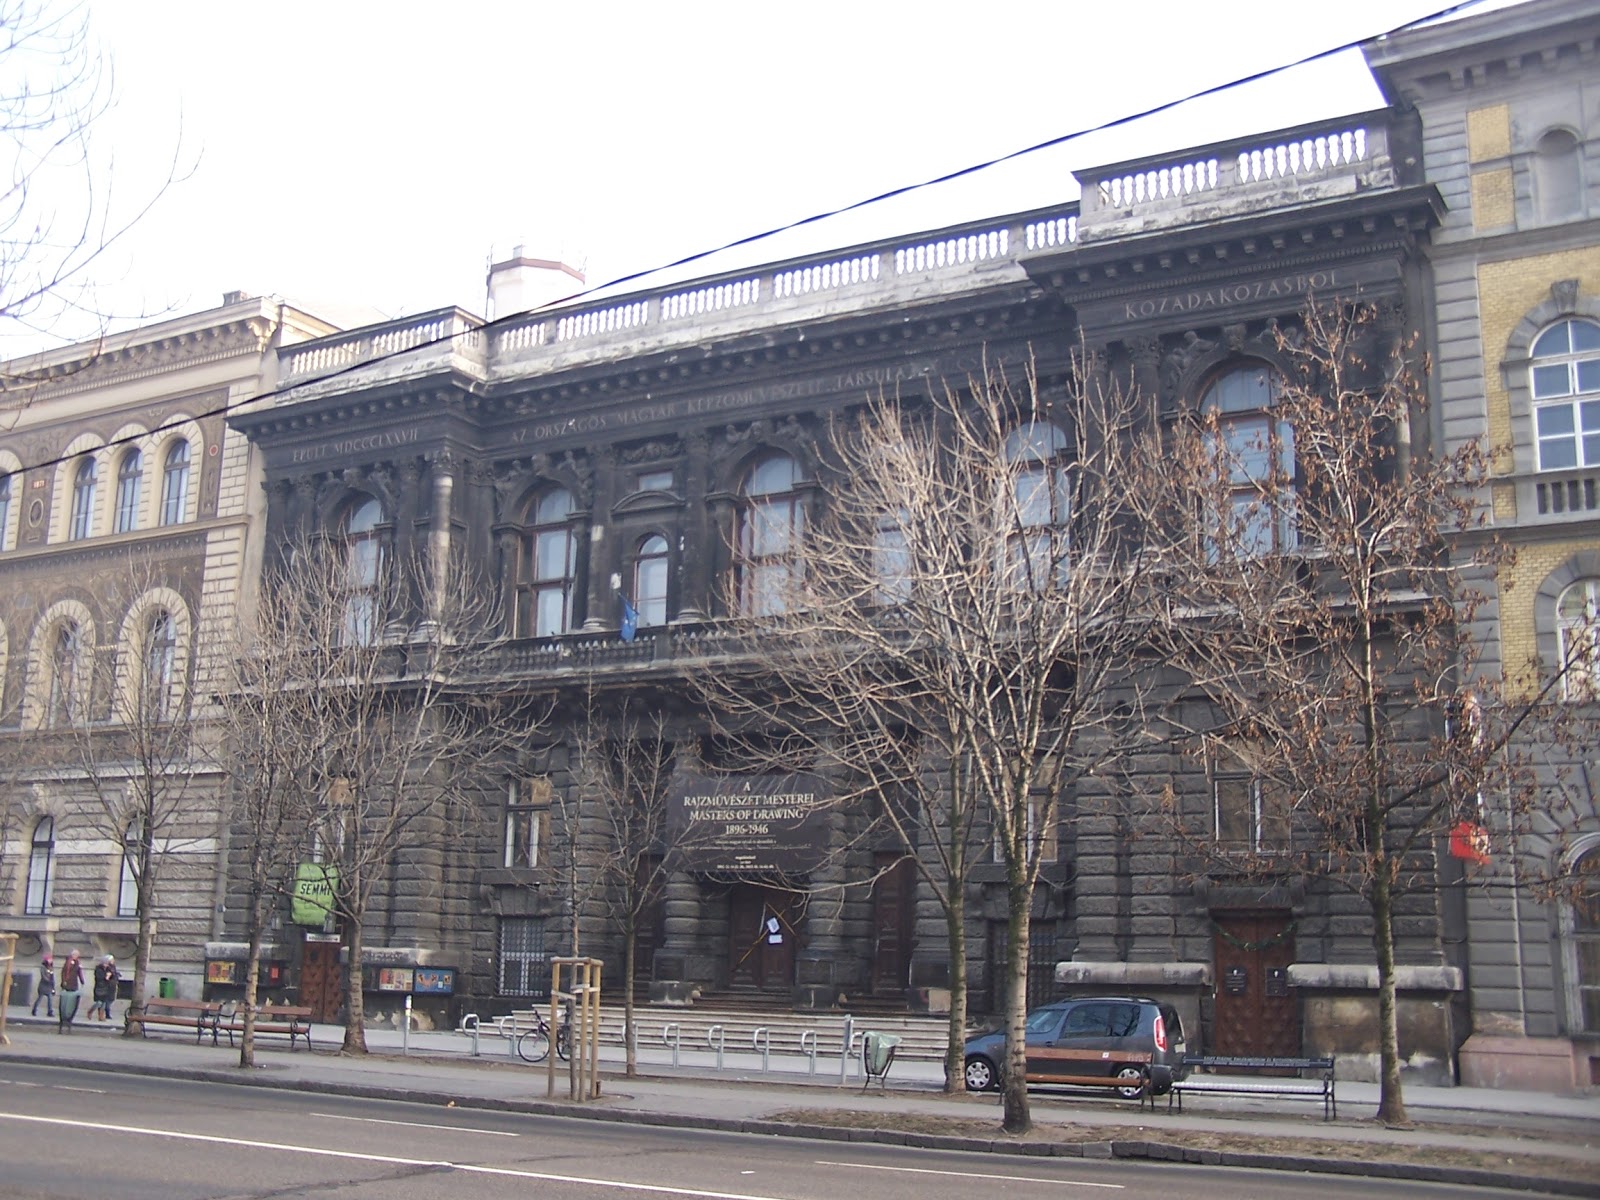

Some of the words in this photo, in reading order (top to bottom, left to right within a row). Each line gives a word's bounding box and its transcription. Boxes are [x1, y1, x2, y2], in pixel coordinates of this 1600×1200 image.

[743, 781, 751, 792] A
[763, 793, 815, 806] MESTEREI
[689, 810, 734, 821] MASTERS
[736, 810, 750, 820] OF
[753, 808, 804, 820] DRAWING
[725, 824, 768, 835] 1896-1946
